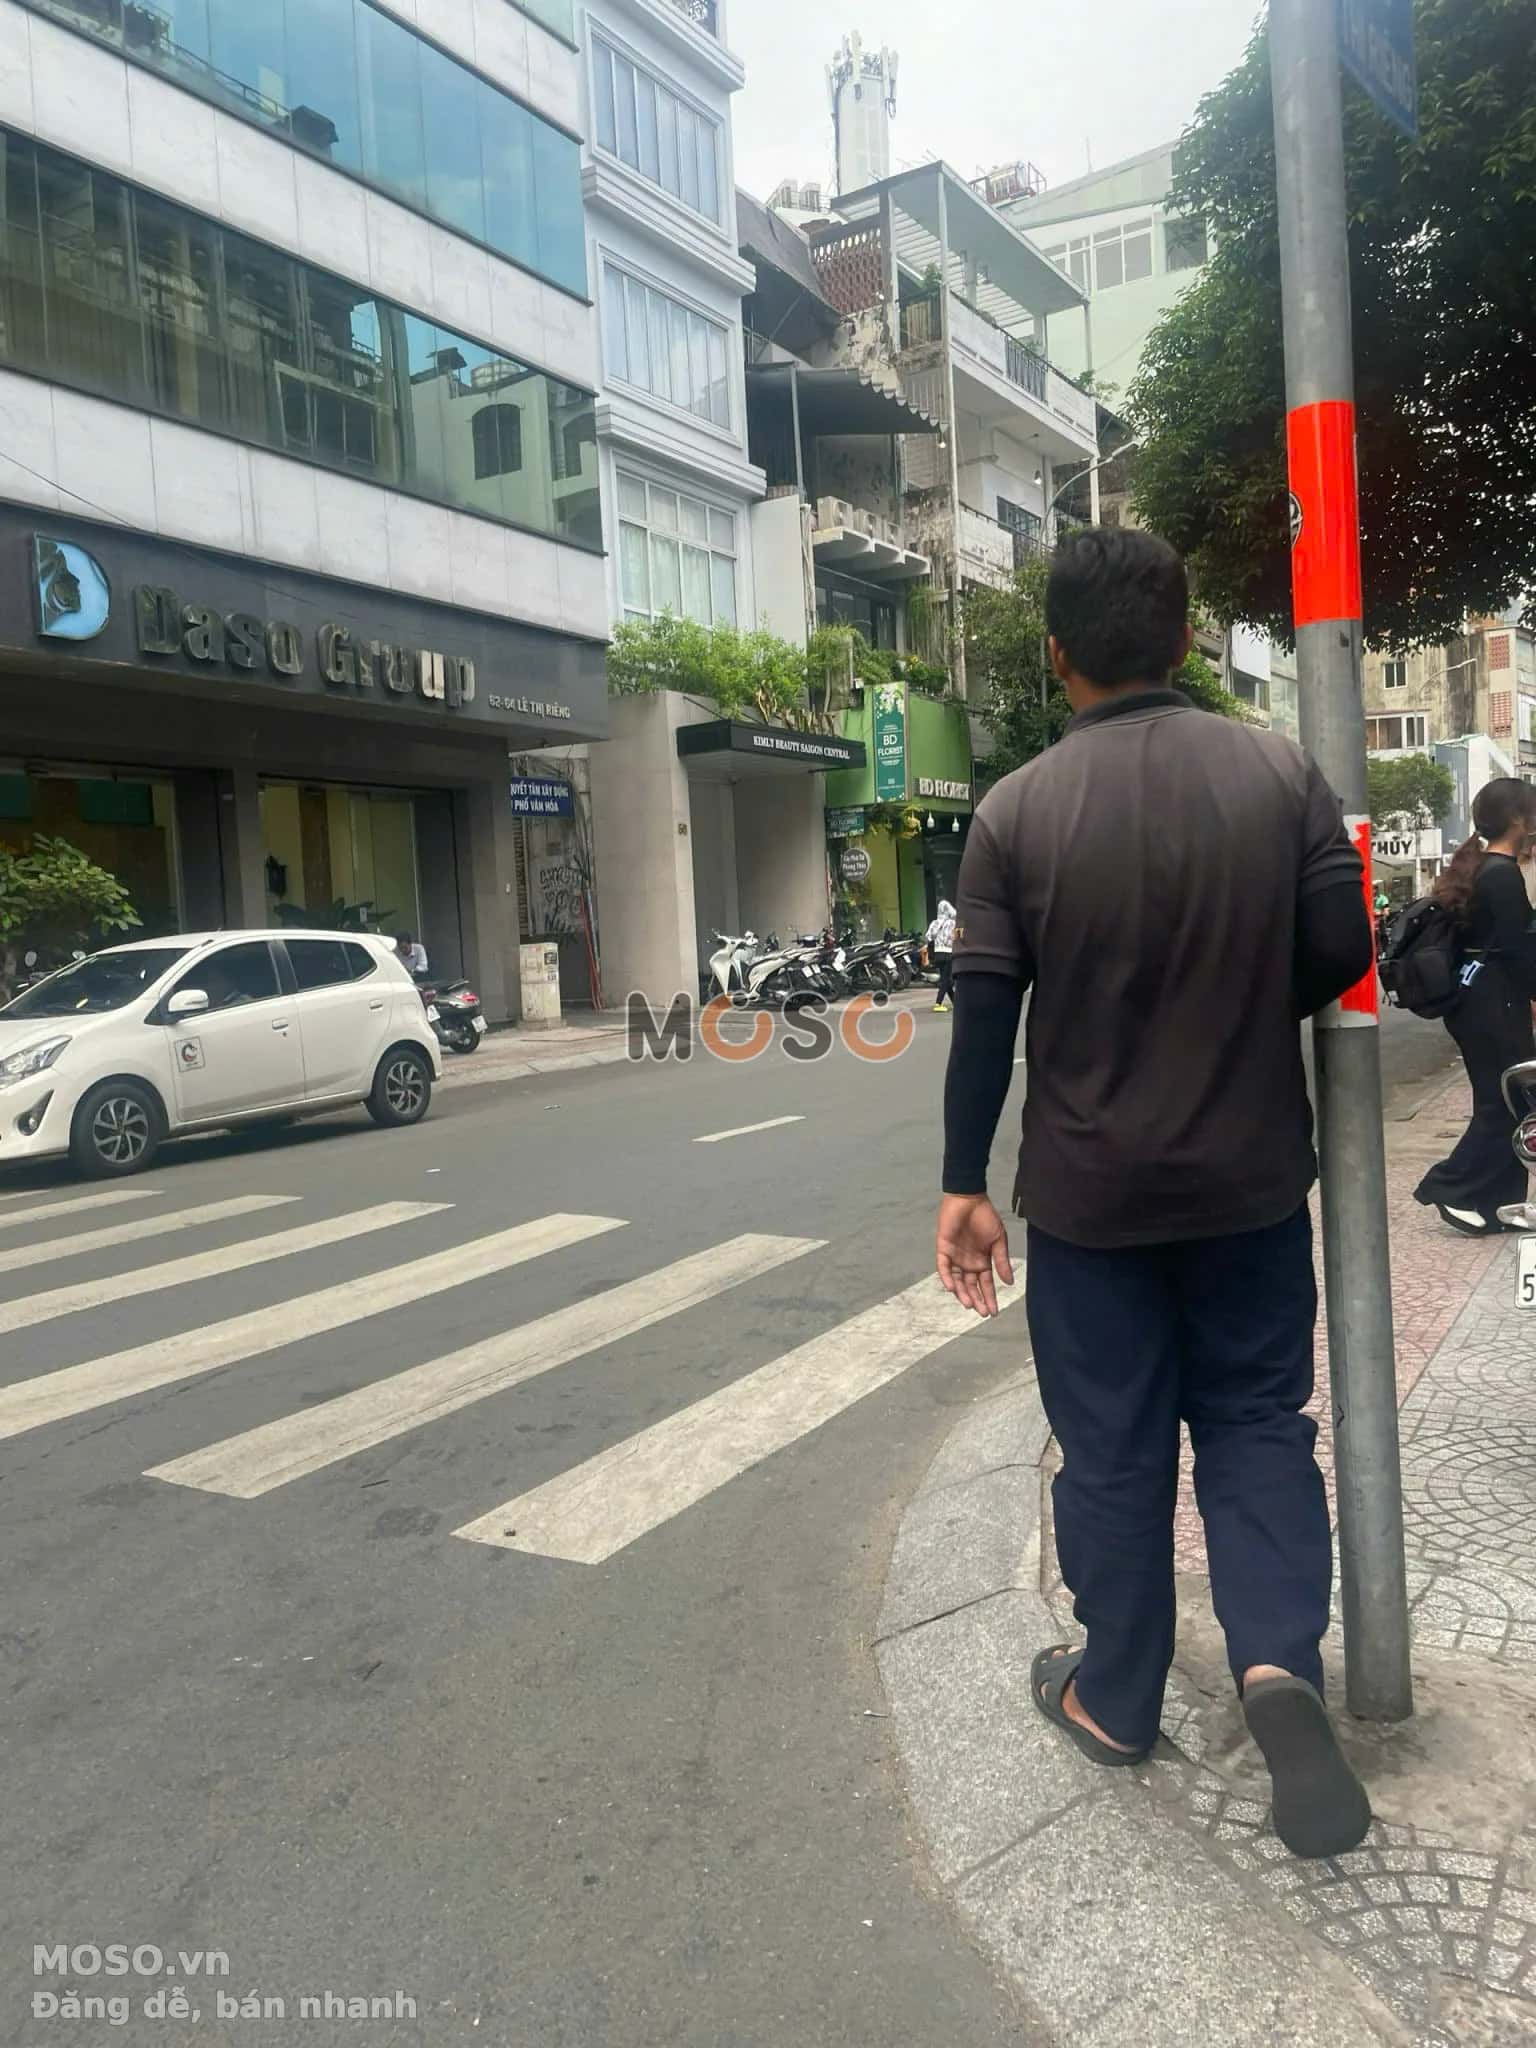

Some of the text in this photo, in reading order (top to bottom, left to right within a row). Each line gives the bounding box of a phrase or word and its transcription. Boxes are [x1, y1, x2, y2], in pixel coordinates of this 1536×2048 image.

[134, 583, 476, 708] Daso Group
[517, 696, 529, 713] LÊ
[529, 700, 545, 718] THỊ
[546, 701, 571, 718] RIÊNG
[775, 739, 801, 753] BEAUTY
[800, 743, 824, 756] SAIGON
[823, 747, 851, 760] CENTRAL
[883, 734, 898, 746] BD
[878, 745, 903, 757] FLORIST
